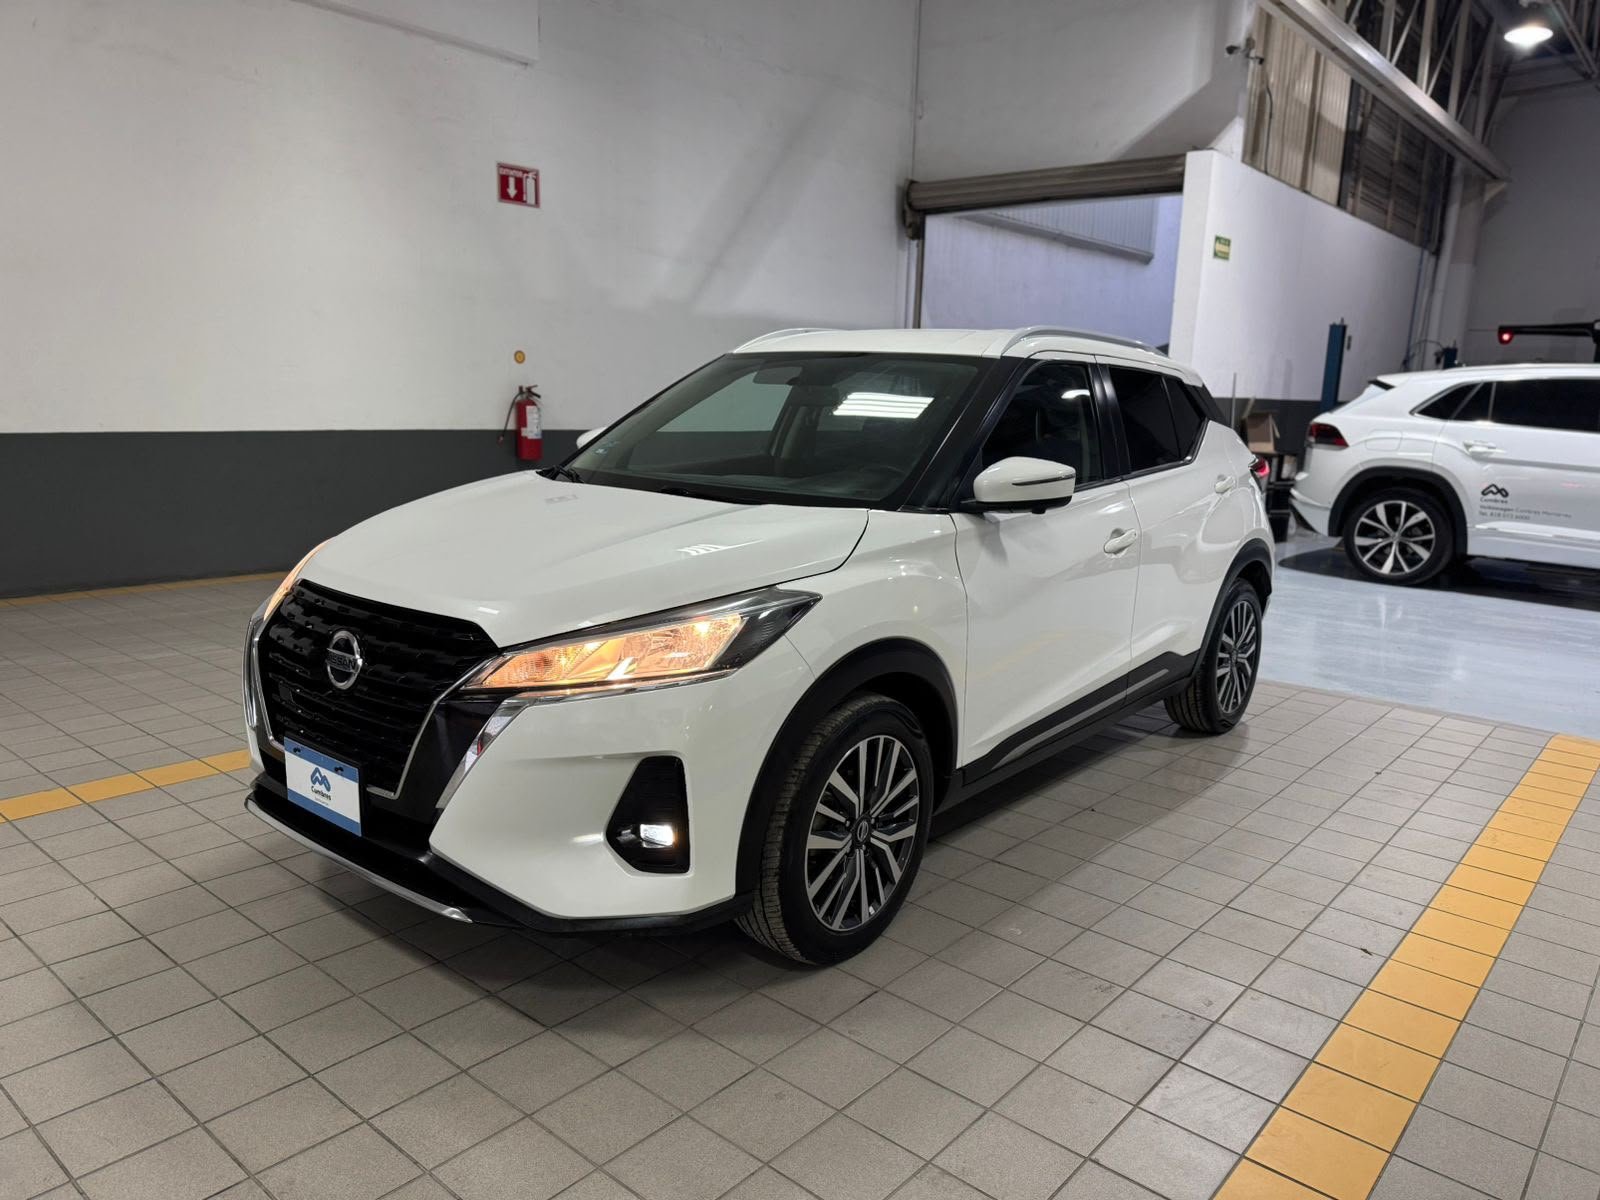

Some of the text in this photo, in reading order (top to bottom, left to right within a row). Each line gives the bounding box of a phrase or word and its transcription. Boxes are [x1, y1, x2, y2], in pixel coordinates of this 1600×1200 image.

[1480, 496, 1508, 504] Cumbres
[327, 653, 357, 671] NISSAN
[311, 785, 332, 801] Cumbres
